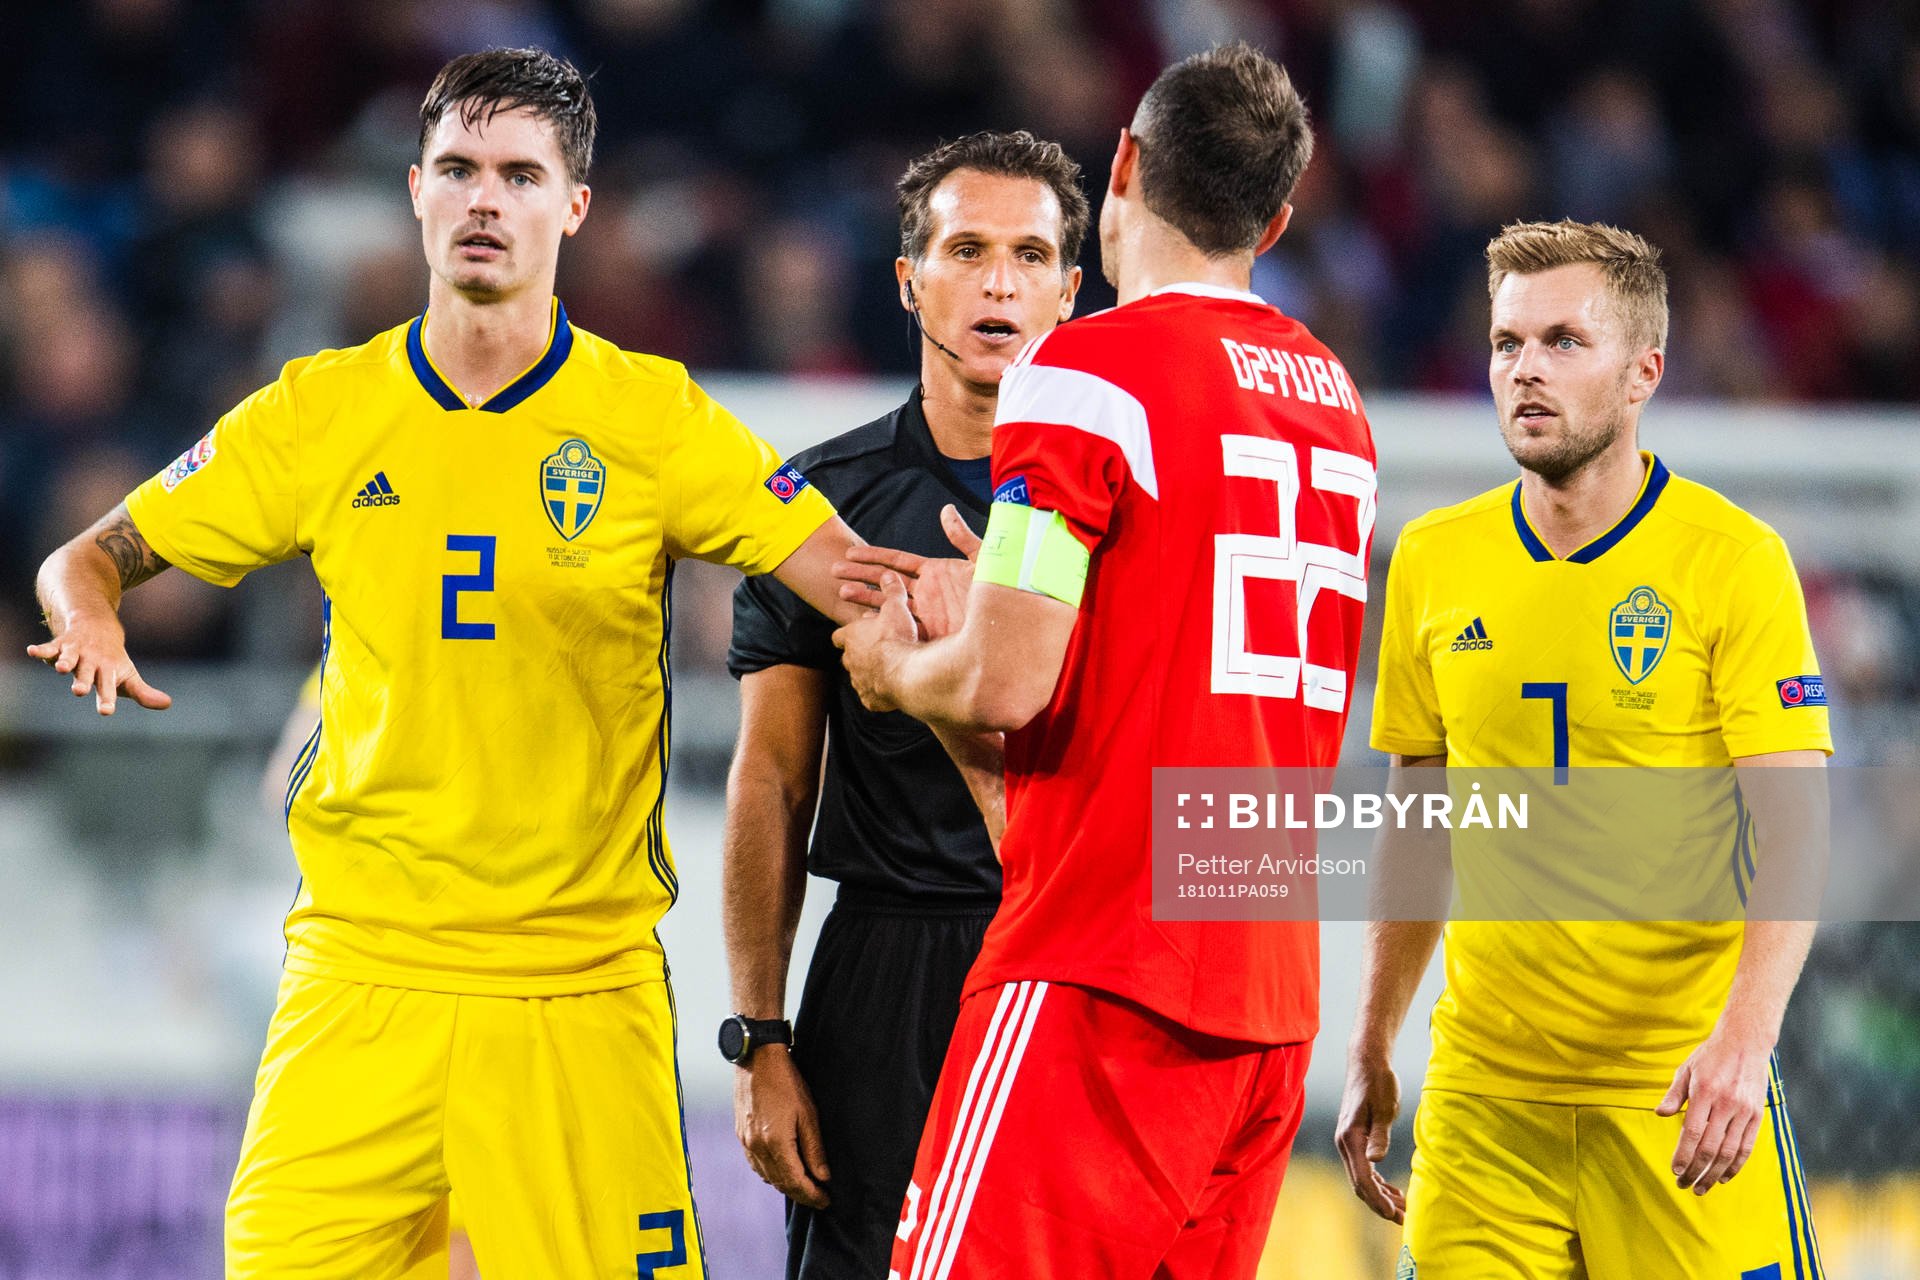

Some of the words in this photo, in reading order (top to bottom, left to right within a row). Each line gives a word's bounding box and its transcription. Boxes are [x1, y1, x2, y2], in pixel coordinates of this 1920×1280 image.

[1220, 337, 1357, 415] DZYUBA
[552, 468, 594, 479] SVERIGE
[352, 494, 401, 508] adidas
[442, 534, 496, 640] 2
[1211, 434, 1377, 713] 22
[1621, 615, 1660, 624] SVERIGE
[1451, 639, 1493, 652] adidas
[1521, 682, 1569, 785] 7
